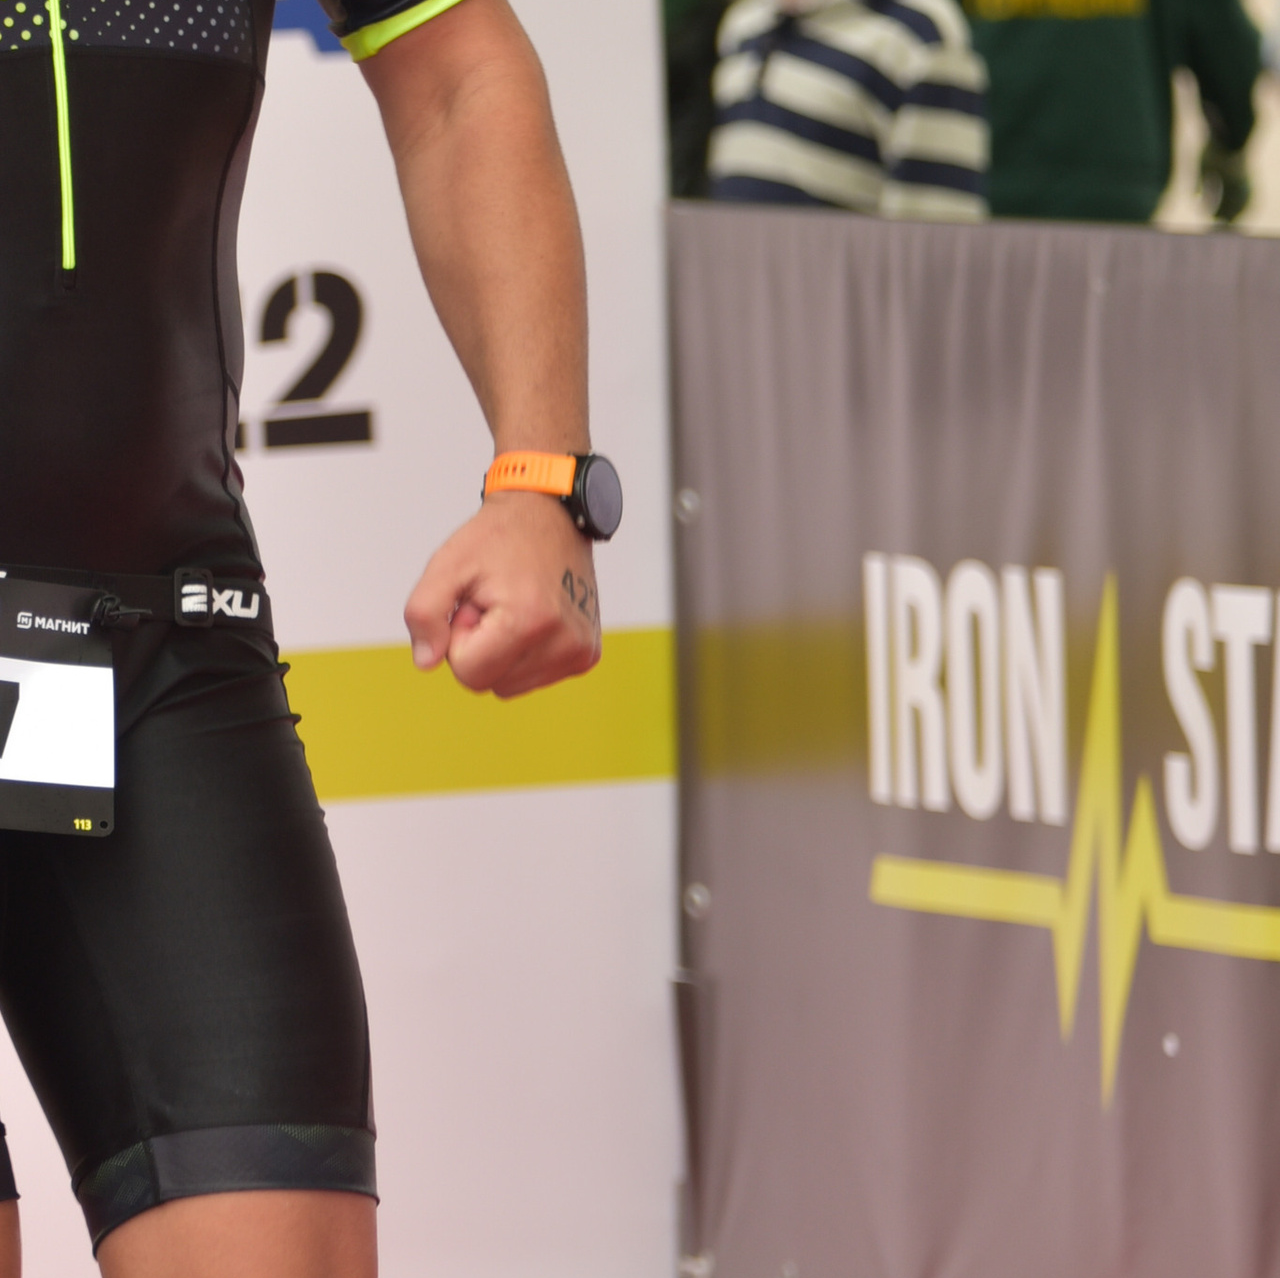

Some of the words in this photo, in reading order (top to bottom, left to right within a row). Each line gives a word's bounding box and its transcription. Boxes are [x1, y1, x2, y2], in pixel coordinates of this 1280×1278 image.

[235, 270, 372, 449] 2
[35, 616, 90, 635] МАГНИТ
[862, 550, 1068, 827] IRON
[1161, 575, 1280, 856] ST
[73, 818, 92, 831] 113
